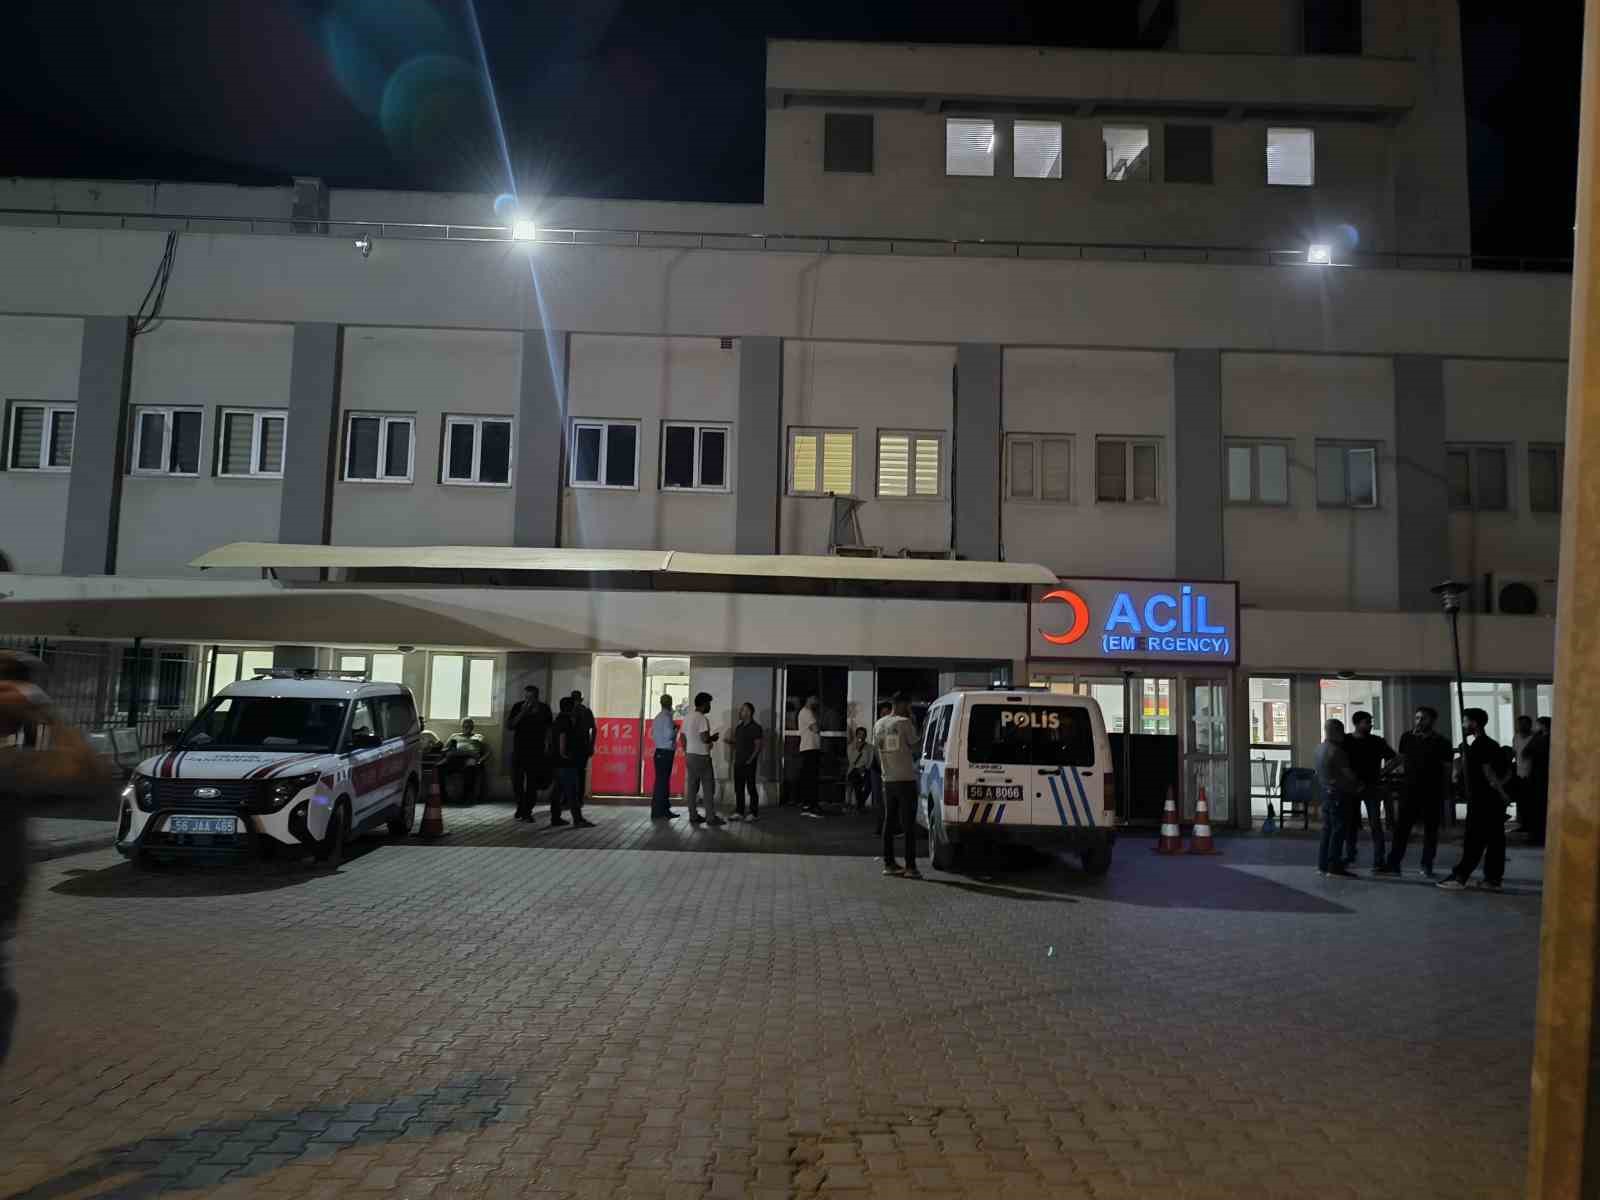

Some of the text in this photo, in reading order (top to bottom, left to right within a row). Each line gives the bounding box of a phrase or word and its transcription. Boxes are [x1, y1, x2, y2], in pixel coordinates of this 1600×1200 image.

[1104, 584, 1226, 634] ACİL
[1000, 710, 1061, 729] POLİS
[600, 723, 633, 738] 112
[970, 786, 983, 797] 56
[986, 786, 993, 797] A
